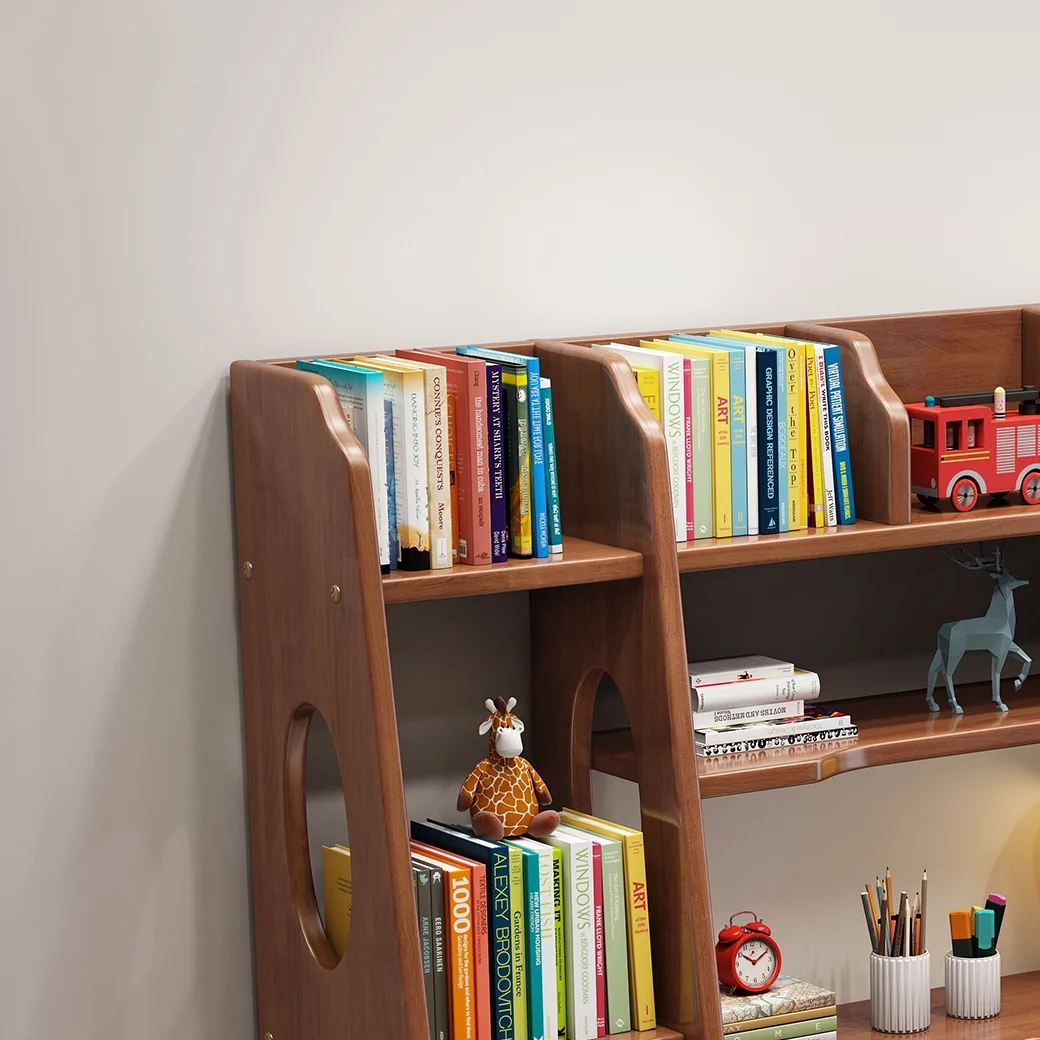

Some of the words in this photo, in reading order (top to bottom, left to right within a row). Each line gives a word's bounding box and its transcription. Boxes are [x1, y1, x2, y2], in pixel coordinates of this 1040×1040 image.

[765, 367, 773, 406] GRAPHIC
[827, 363, 840, 389] VIRTUAL
[433, 377, 443, 426] CONNIE'S
[475, 397, 483, 408] the
[491, 371, 500, 413] MYSTERY
[667, 361, 681, 438] WINDOWS
[830, 390, 843, 415] PATIENT
[411, 393, 419, 432] DANCING
[493, 416, 501, 428] AT
[717, 396, 728, 424] ART
[733, 395, 744, 424] ART
[475, 409, 484, 449] handsomest
[832, 416, 846, 452] SIMULATION
[434, 428, 444, 491] CONQUESTS
[476, 451, 484, 465] man
[493, 430, 502, 468] SHARK'S
[778, 422, 786, 469] BORDEAUX
[412, 453, 420, 468] JOY
[477, 467, 484, 475] in
[766, 443, 774, 499] REFERENCED
[477, 476, 485, 492] cuba
[494, 470, 503, 499] TEETH
[826, 489, 834, 502] Jeff
[437, 502, 445, 530] Moore
[714, 711, 746, 722] METHODS
[746, 710, 760, 719] AND
[760, 707, 786, 718] MOVIES
[493, 853, 509, 921] ALEXEY
[576, 847, 590, 930] WINDOWS
[633, 882, 646, 910] ART
[452, 876, 471, 934] 1000
[554, 910, 560, 922] IT
[422, 917, 430, 936] ARNE
[513, 911, 522, 951] Gardens
[515, 952, 522, 963] in
[515, 965, 523, 997] France
